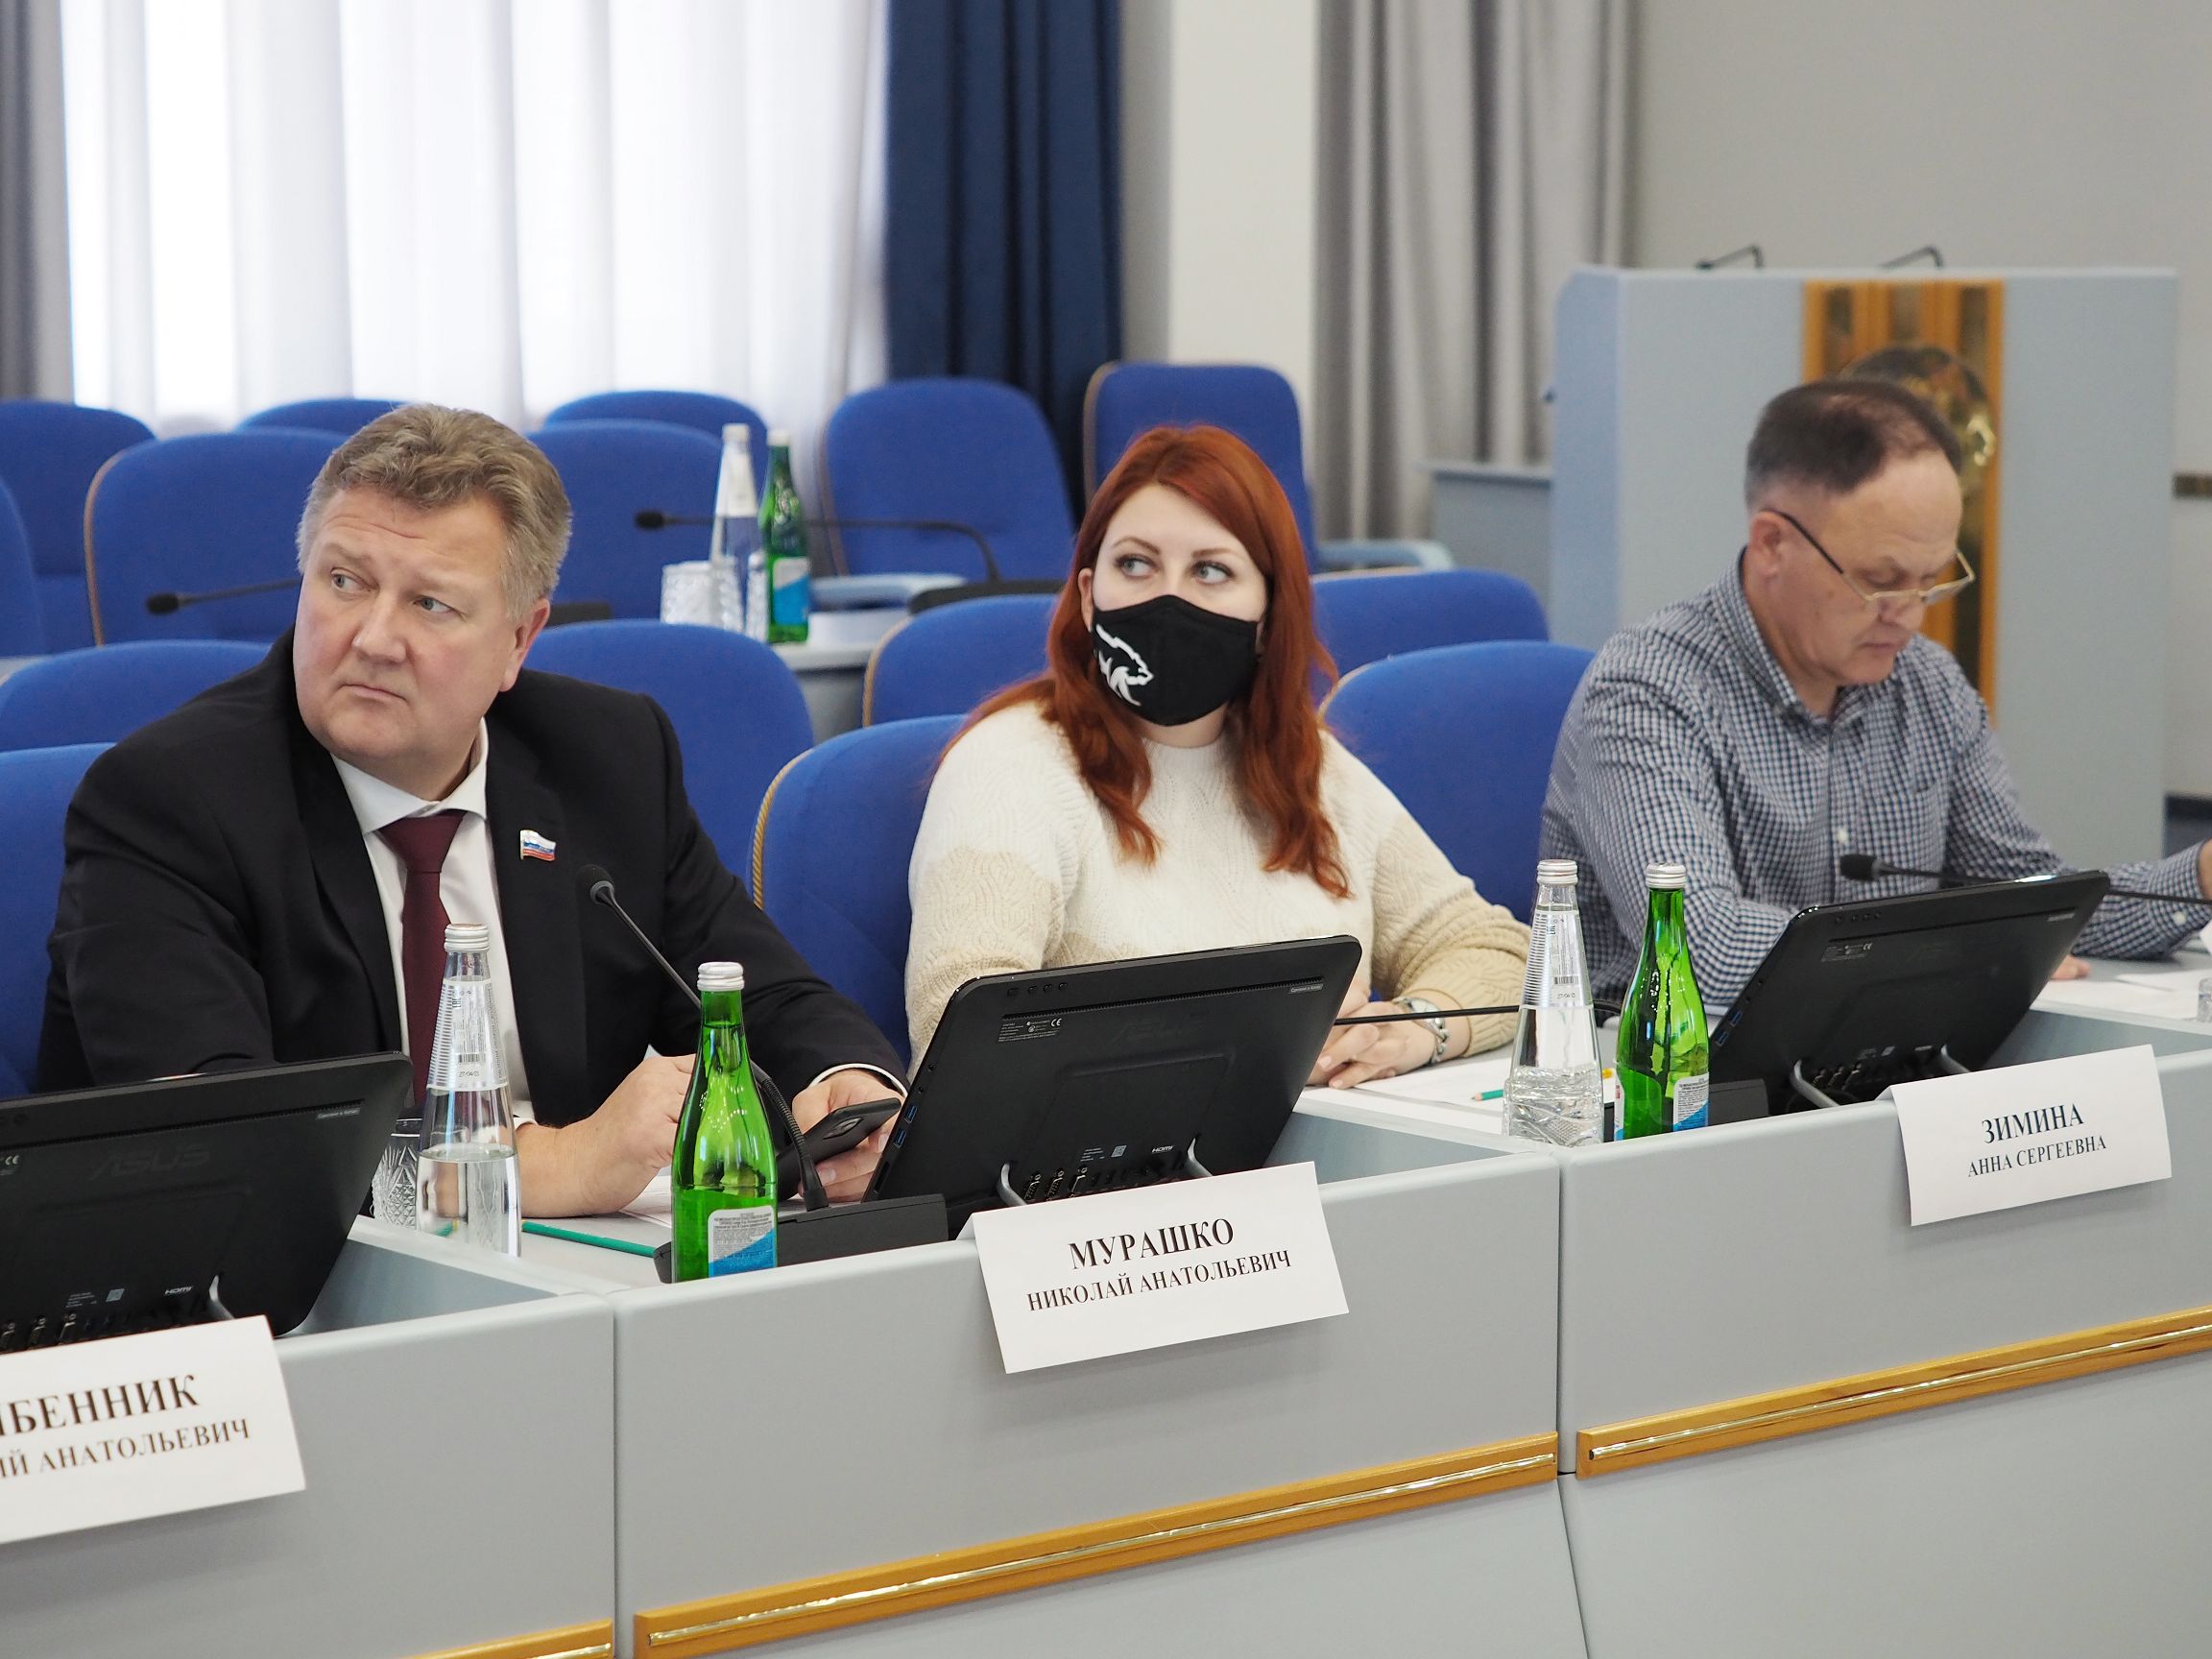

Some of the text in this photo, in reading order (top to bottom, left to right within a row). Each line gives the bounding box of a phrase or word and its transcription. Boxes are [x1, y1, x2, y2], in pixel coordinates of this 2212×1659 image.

[1981, 1103, 2084, 1144] ЗИМИНА
[1967, 1135, 2107, 1178] АННА СЕРГЕЕВНА
[1068, 1217, 1235, 1270] МУРАШКО
[1026, 1249, 1292, 1312] НИКОЛАЙ АНАТОЛЬЕВИЧ
[39, 1418, 251, 1474] АНАТОЛЬЕВИЧ
